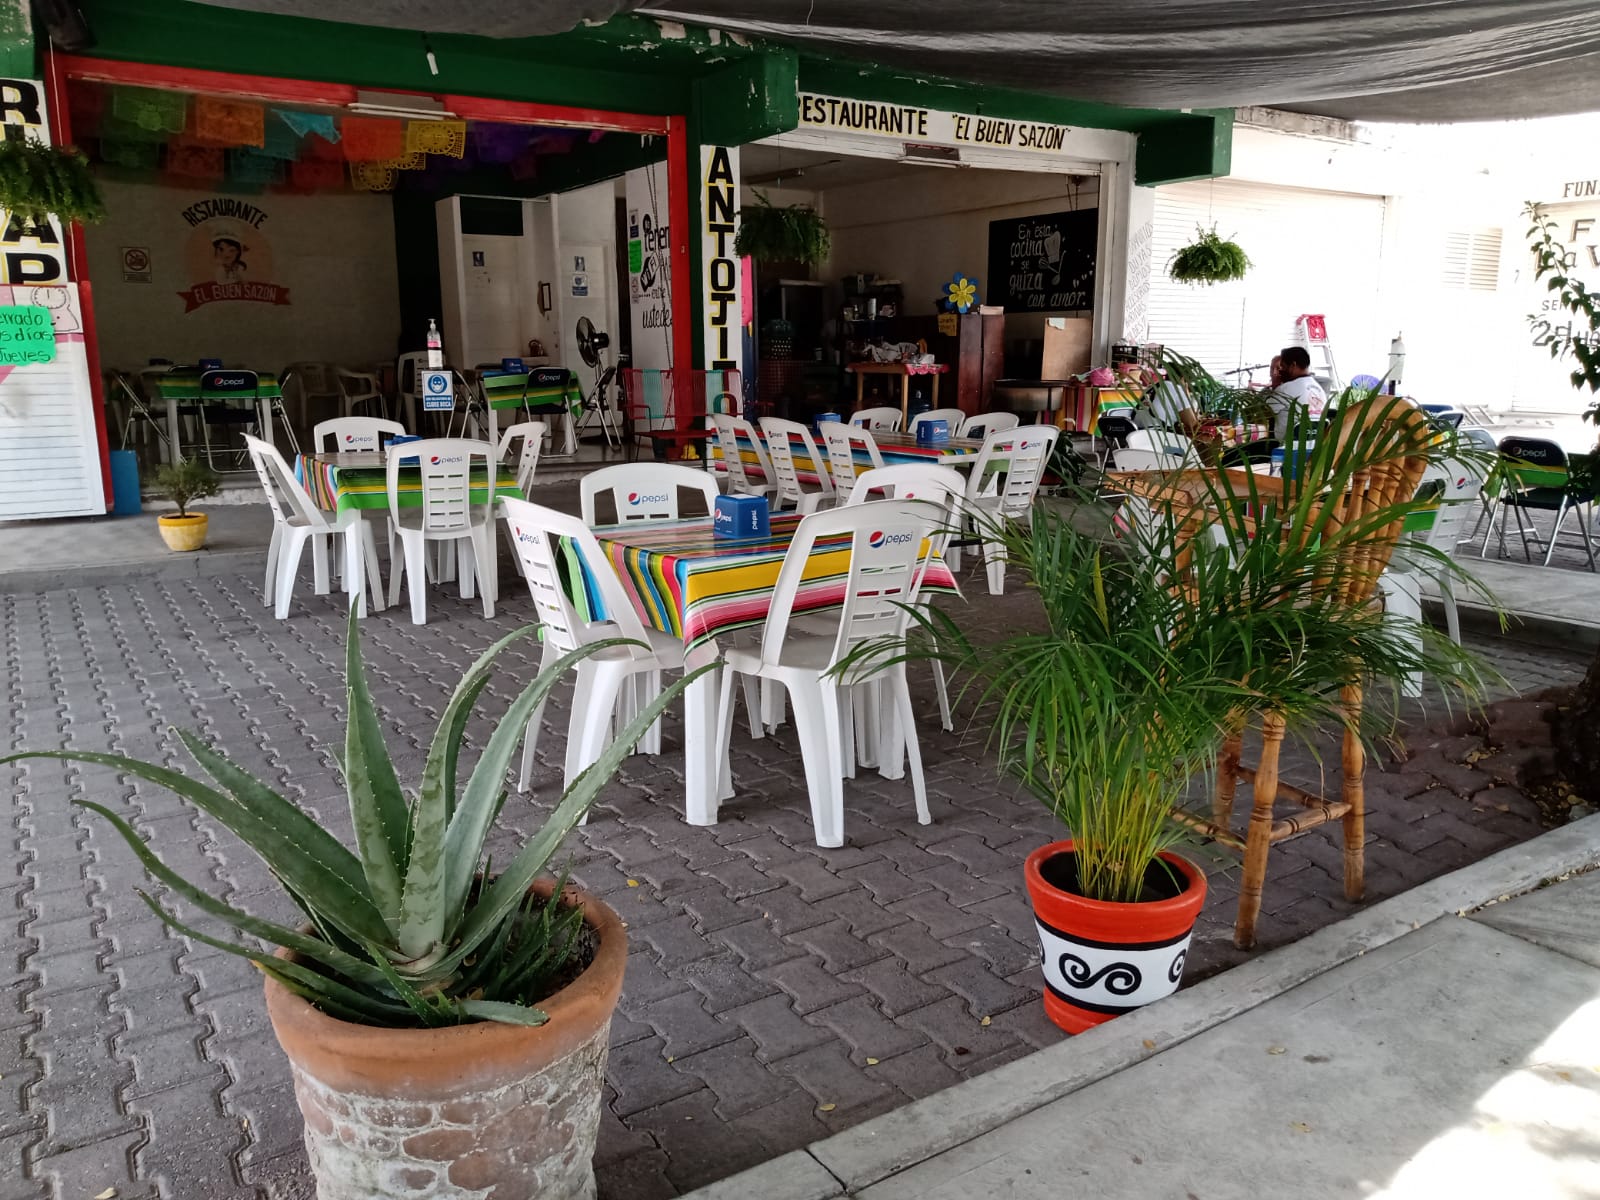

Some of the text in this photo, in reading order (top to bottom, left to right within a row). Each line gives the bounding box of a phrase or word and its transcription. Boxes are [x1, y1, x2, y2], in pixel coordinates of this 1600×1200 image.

[798, 96, 928, 135] ESTAURANTE
[975, 118, 1016, 145] BUEN
[1562, 180, 1600, 198] FUN
[182, 198, 269, 230] RESTAURANTE
[1018, 224, 1051, 240] En esta
[1010, 238, 1045, 258] cocina
[1009, 271, 1043, 296] guiza
[194, 288, 210, 303] EL
[212, 284, 242, 300] BUEN
[15, 327, 53, 341] días
[223, 378, 245, 386] pepsi
[441, 456, 463, 464] pepsi
[1522, 448, 1547, 458] pepsi
[641, 493, 668, 504] pepsi
[885, 532, 913, 546] pepsi
